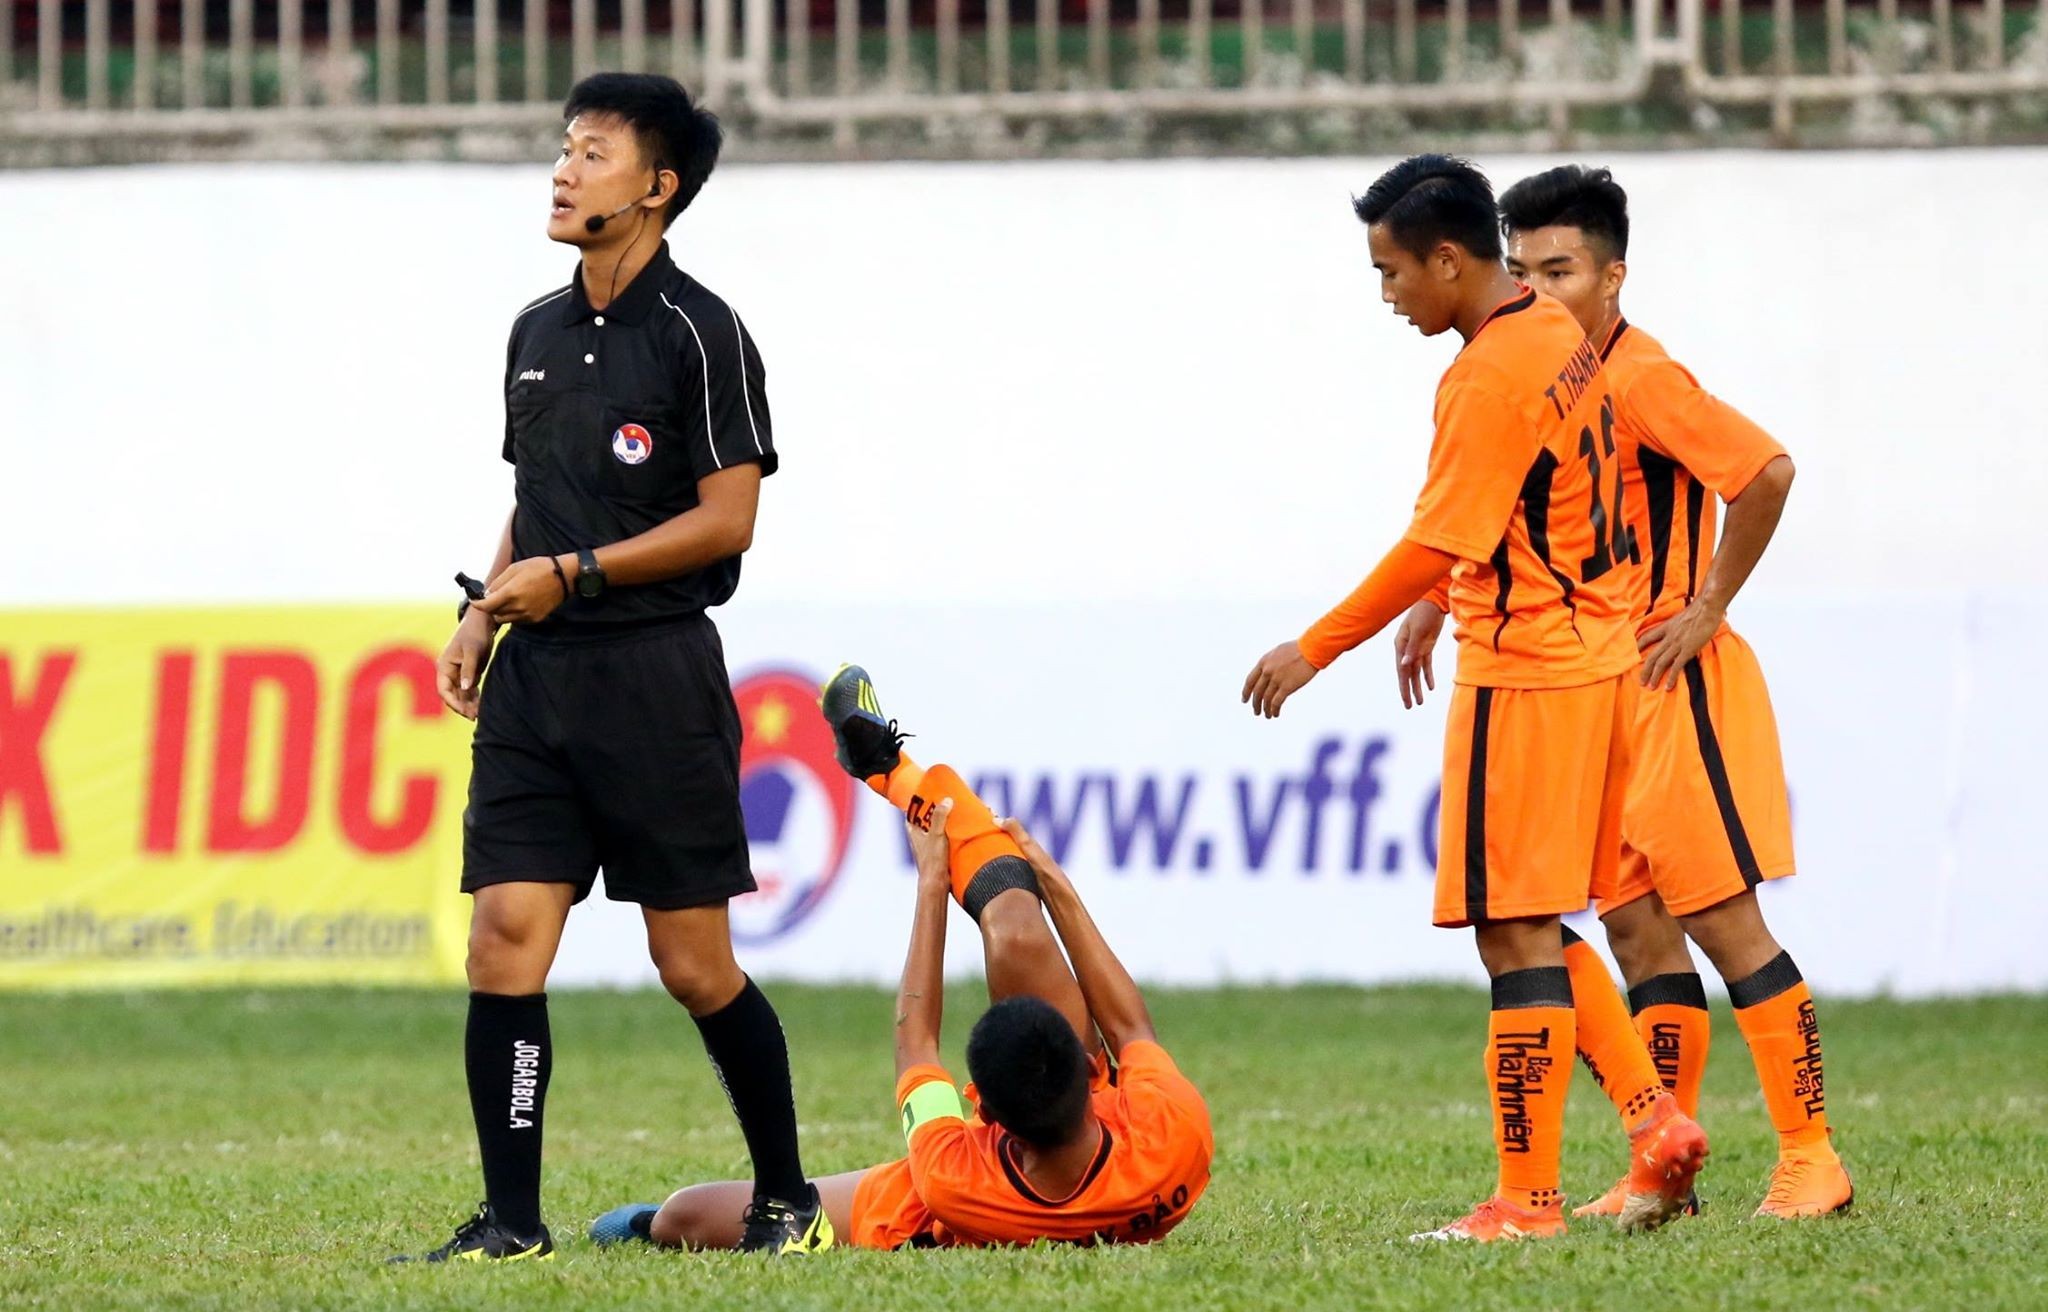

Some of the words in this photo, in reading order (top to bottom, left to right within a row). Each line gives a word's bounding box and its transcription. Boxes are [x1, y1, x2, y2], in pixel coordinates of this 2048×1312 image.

[141, 642, 444, 860] IDC
[213, 899, 432, 960] Education
[509, 1040, 540, 1129] JOGARBOLA
[1525, 1057, 1553, 1083] Báo
[1794, 1068, 1811, 1097] Báo
